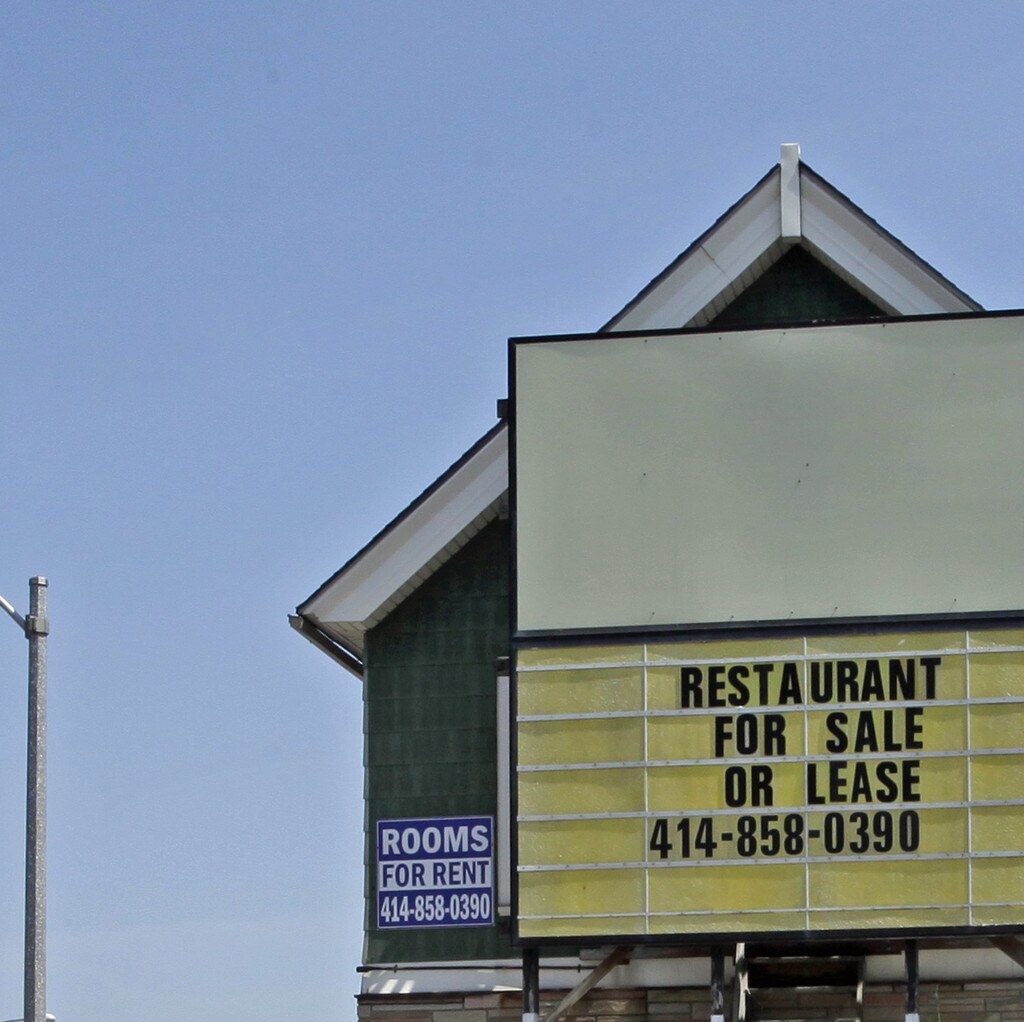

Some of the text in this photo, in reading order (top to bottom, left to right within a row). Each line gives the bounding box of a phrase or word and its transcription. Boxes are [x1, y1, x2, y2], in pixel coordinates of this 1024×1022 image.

[681, 657, 941, 709] RESTAURANT
[715, 707, 924, 758] FOR SALE
[725, 760, 921, 808] OR LEASE
[382, 825, 489, 855] ROOMS
[650, 810, 920, 859] 414-858-0390
[382, 861, 490, 888] FOR RENT
[380, 893, 491, 923] 414-858-0390
